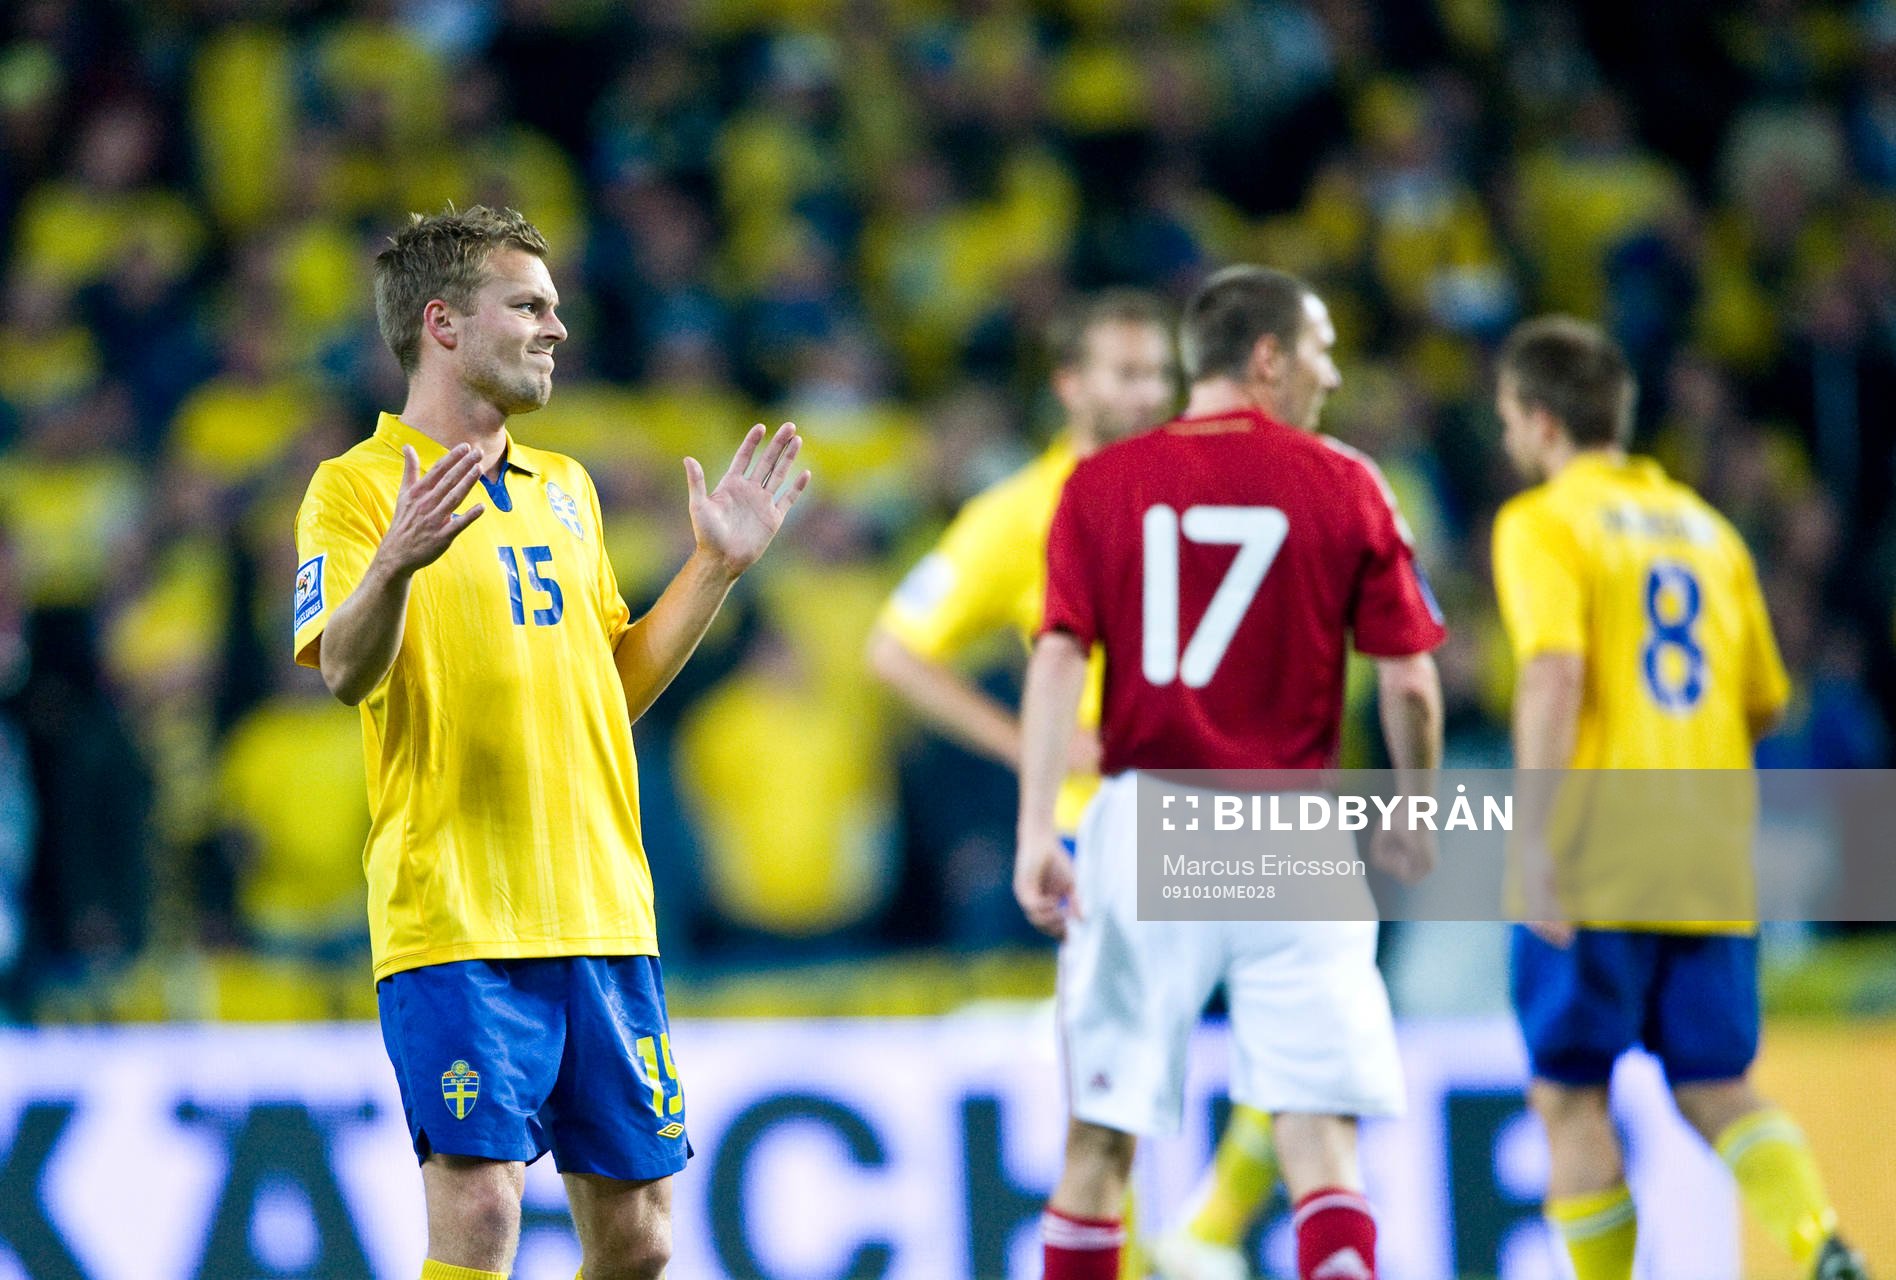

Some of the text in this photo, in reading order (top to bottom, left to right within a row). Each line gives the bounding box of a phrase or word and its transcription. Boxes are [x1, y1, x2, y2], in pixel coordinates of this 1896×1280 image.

[497, 545, 564, 626] 15
[1141, 503, 1290, 689] 17
[1640, 559, 1707, 716] 8
